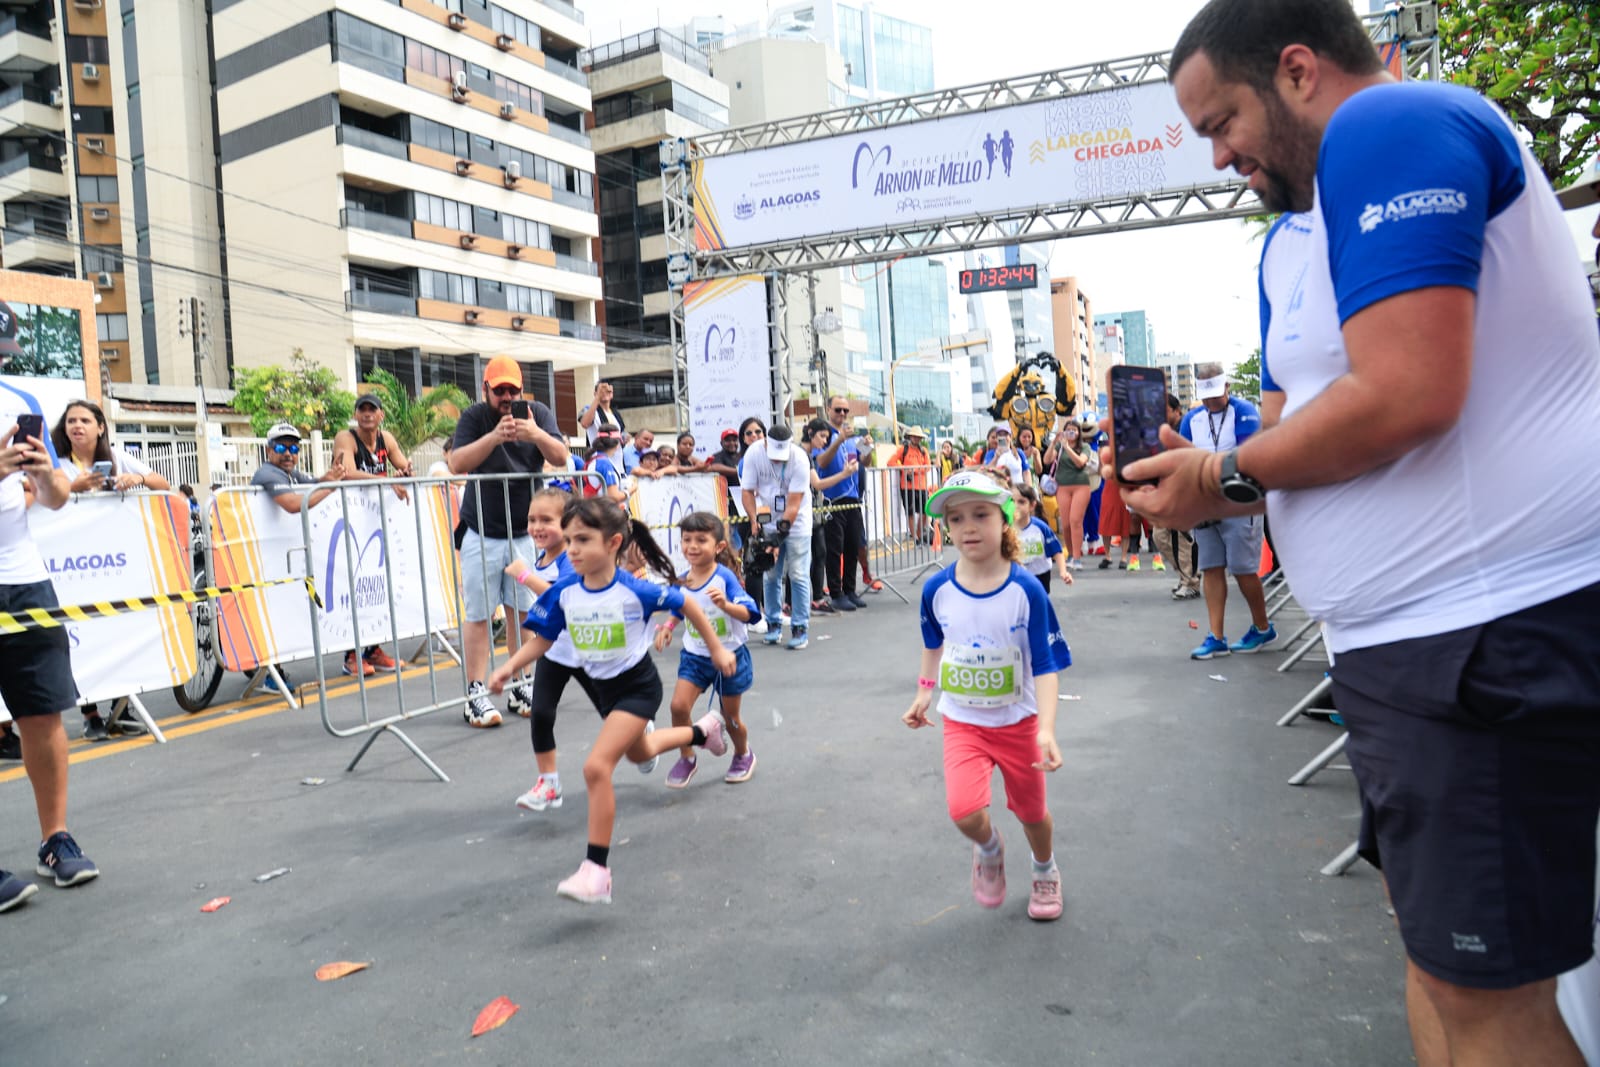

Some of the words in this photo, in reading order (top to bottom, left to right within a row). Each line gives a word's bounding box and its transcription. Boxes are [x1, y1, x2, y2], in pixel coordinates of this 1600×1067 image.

[1047, 127, 1133, 152] LARGADA
[1074, 137, 1164, 162] CHEGADA
[874, 168, 922, 196] ARNON
[923, 168, 937, 186] DE
[938, 159, 982, 187] MELLO
[760, 189, 821, 209] ALAGOAS
[1384, 192, 1468, 220] ALAGOAS
[43, 552, 126, 573] LAGOAS
[356, 575, 385, 594] ARNON
[573, 623, 613, 645] 3971
[947, 666, 1005, 691] 3969
